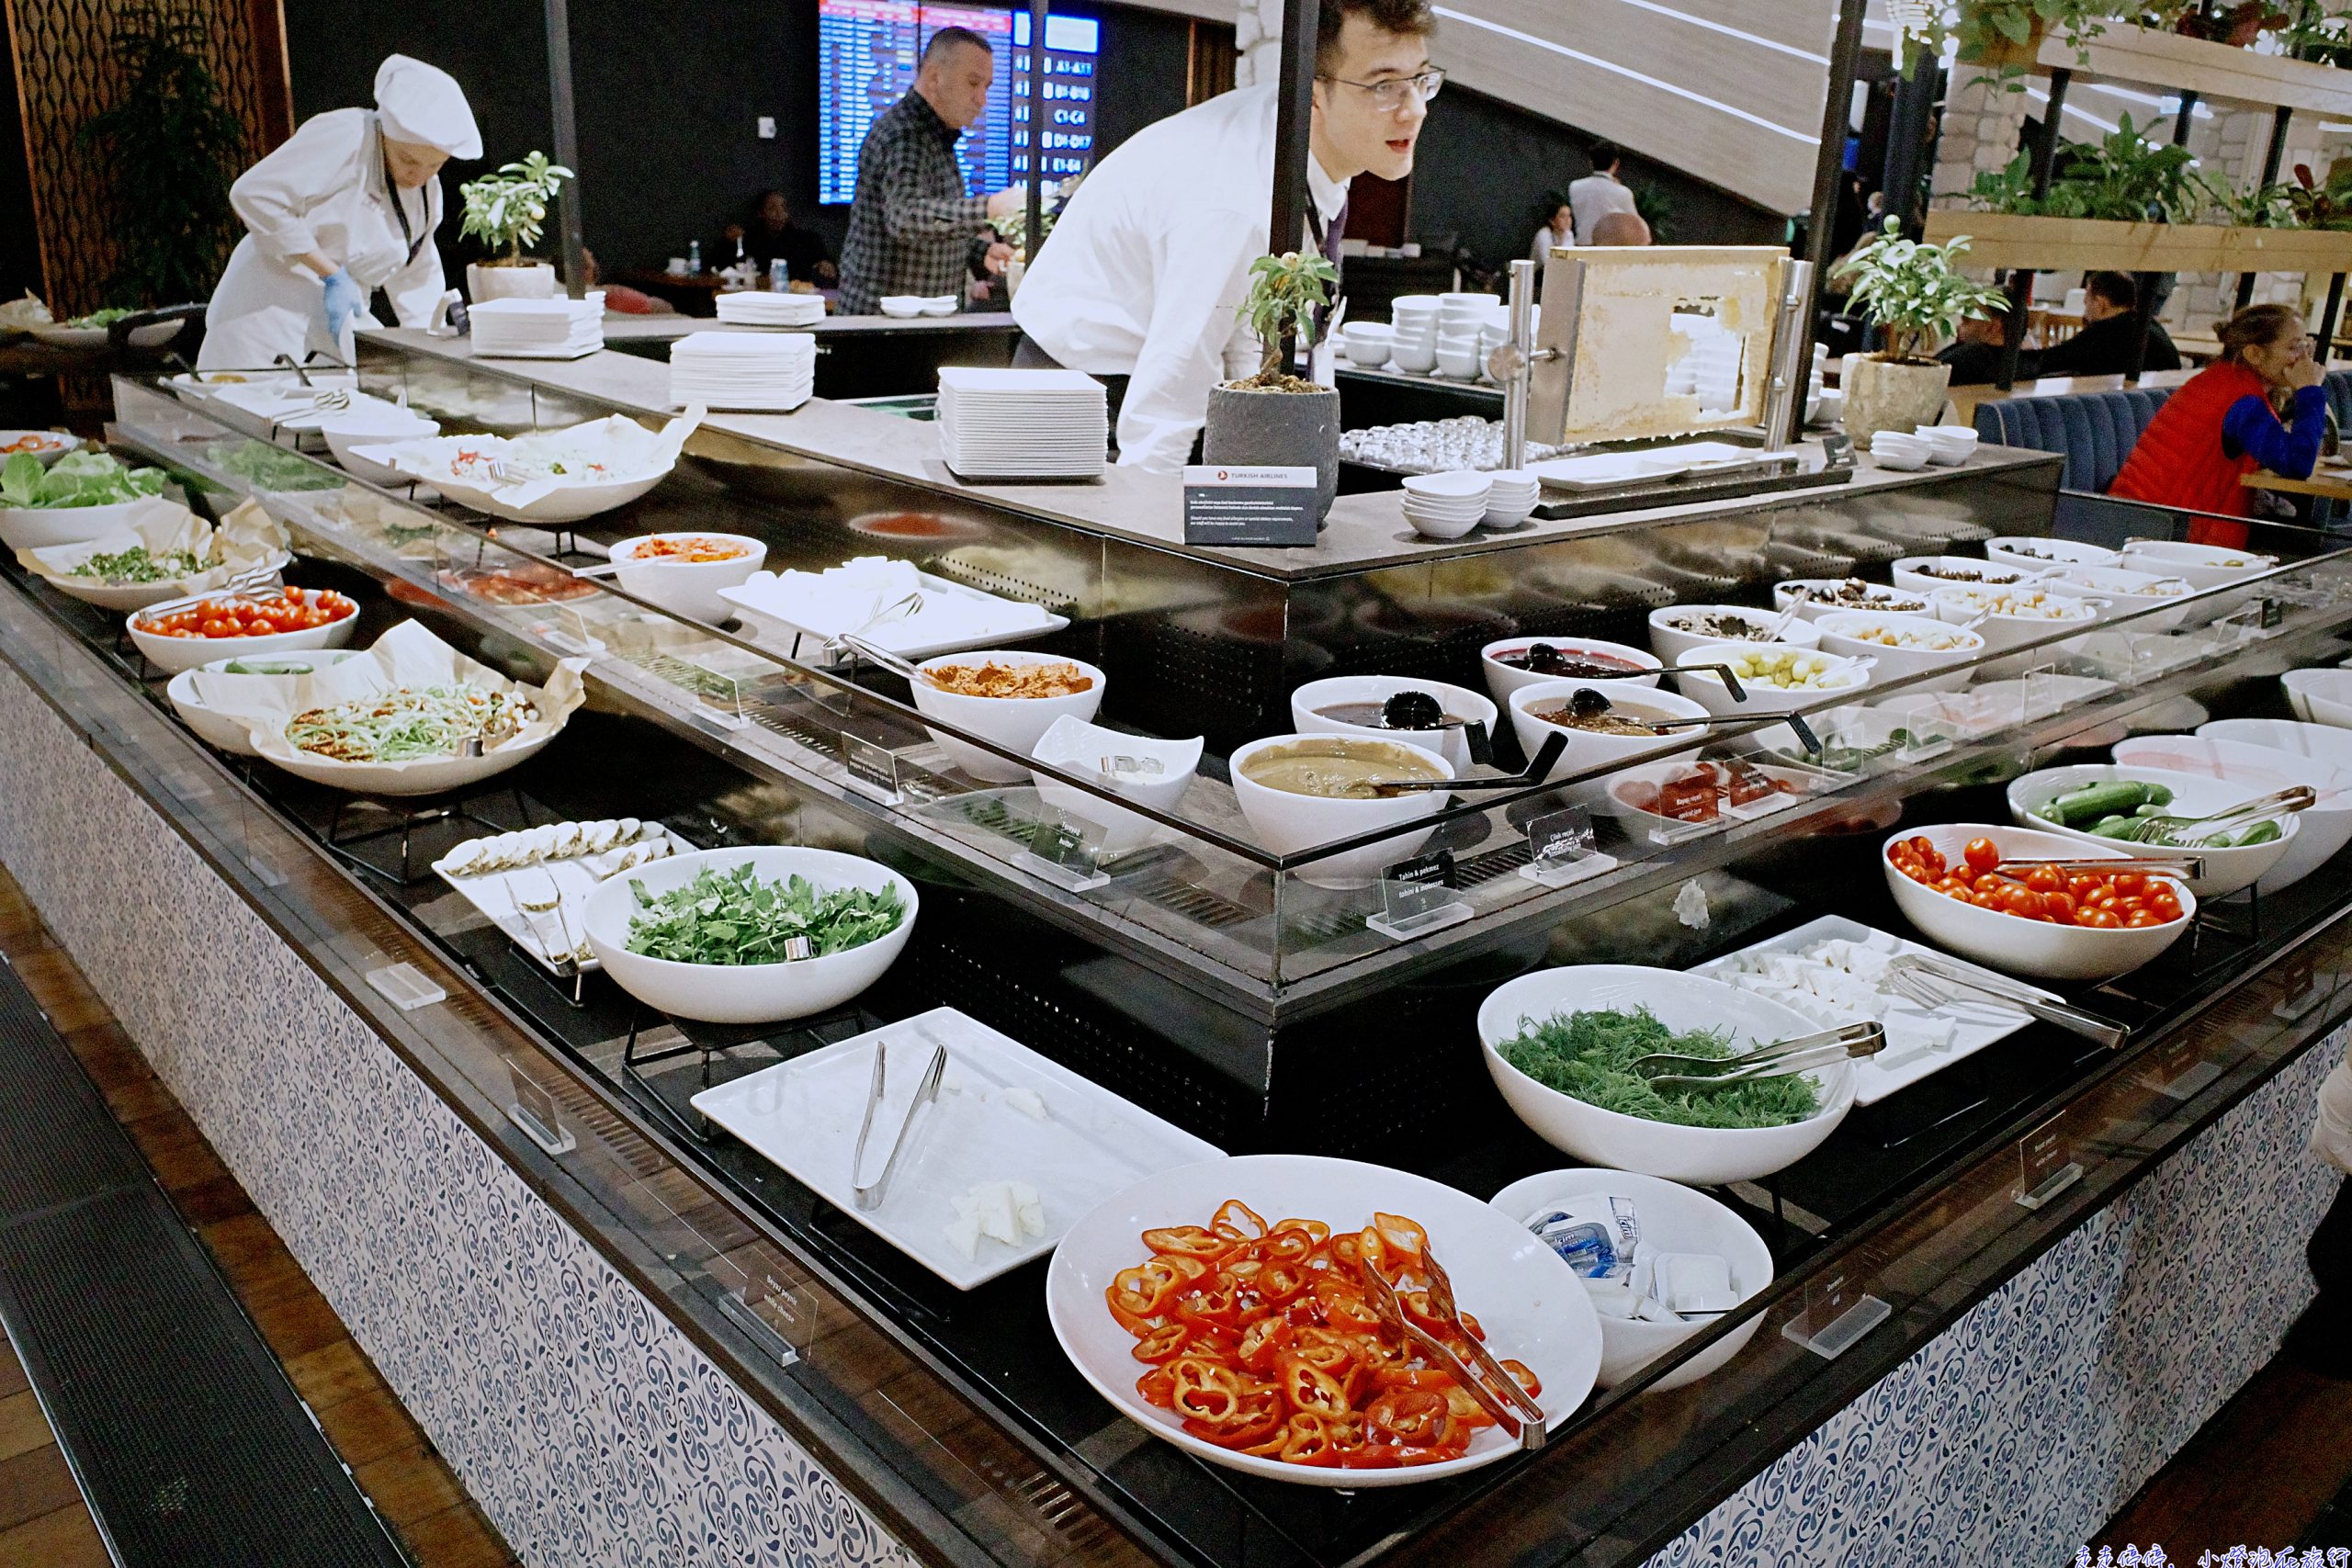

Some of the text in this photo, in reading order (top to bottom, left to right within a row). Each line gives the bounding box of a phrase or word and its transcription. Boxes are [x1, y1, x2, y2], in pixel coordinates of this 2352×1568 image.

[1058, 837, 1074, 848] butter
[1398, 863, 1440, 881] Tahin & pekmez
[1398, 887, 1415, 899] tahini
[1419, 879, 1444, 893] molasses
[763, 1293, 795, 1324] white cheese
